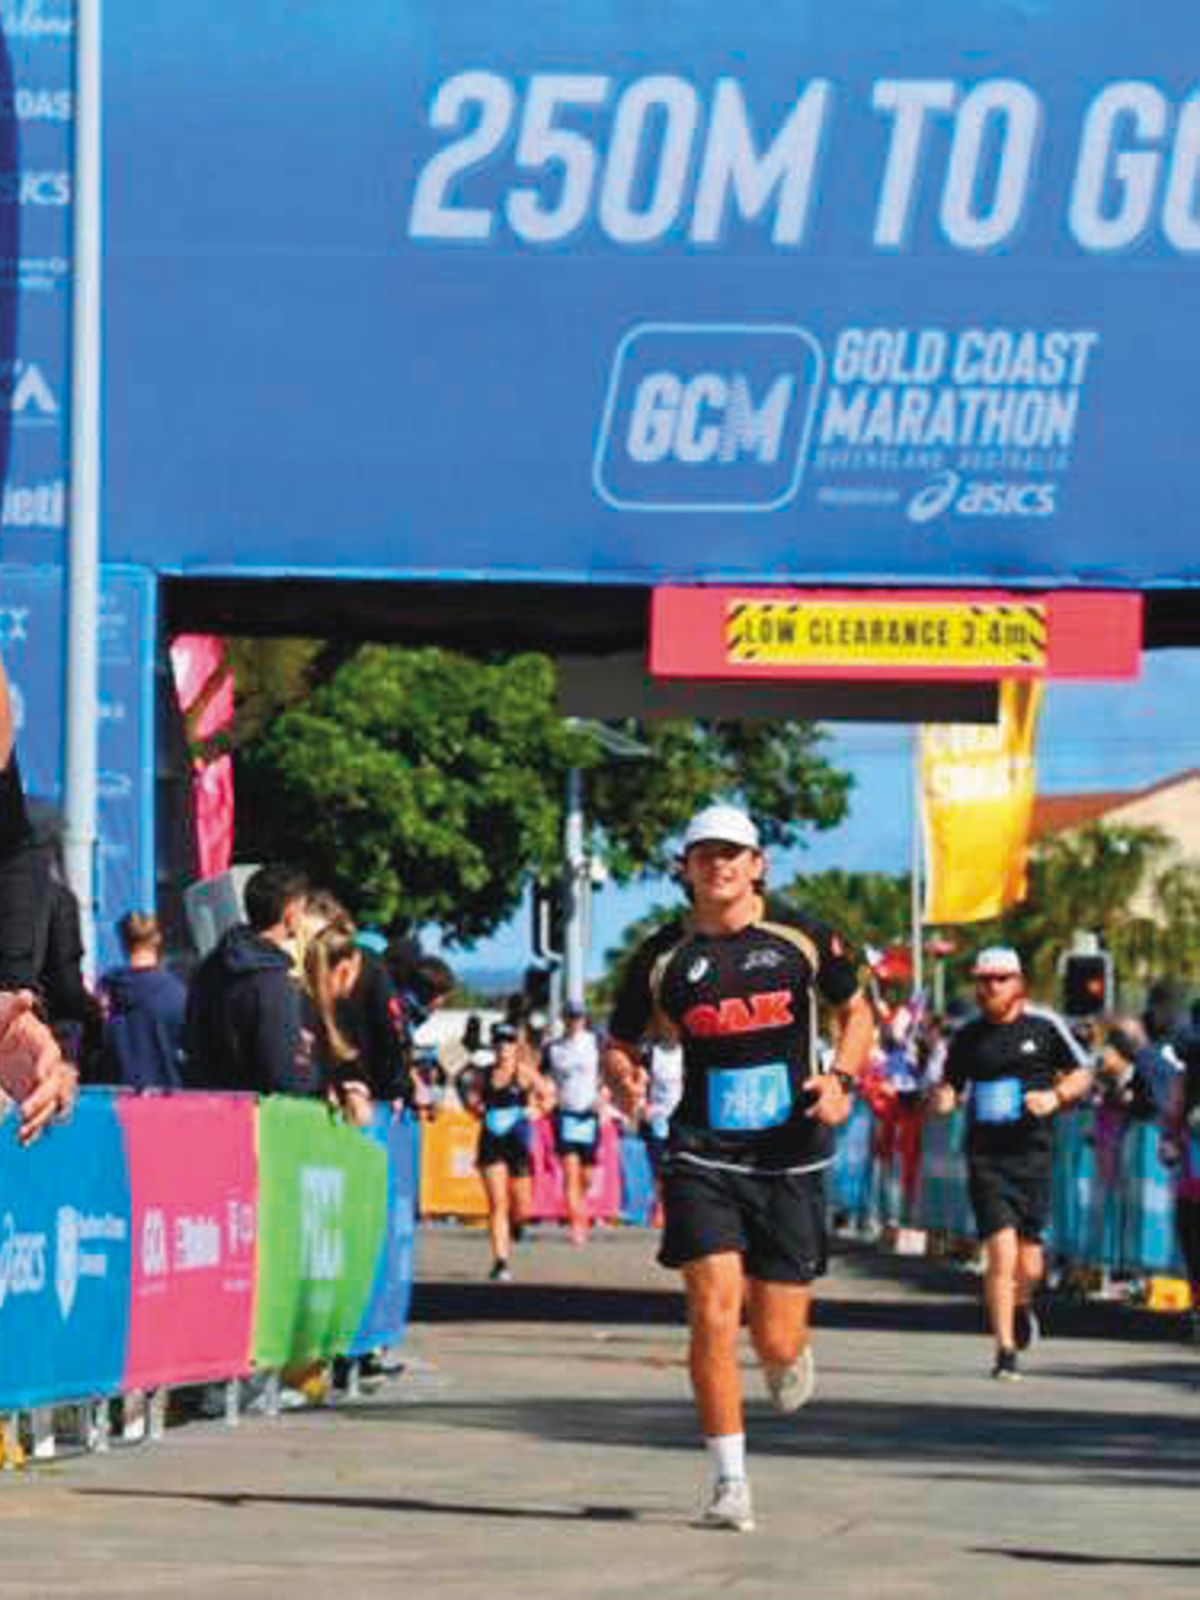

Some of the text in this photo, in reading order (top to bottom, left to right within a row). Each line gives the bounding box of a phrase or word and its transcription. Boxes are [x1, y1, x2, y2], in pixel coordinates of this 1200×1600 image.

[408, 69, 832, 245] 250M
[871, 79, 1040, 250] TO
[833, 328, 1100, 385] GOLD COAST
[627, 372, 794, 464] GCM
[820, 386, 1081, 446] MARATHON
[744, 617, 796, 645] LOW
[808, 617, 950, 647] CLEARANCE
